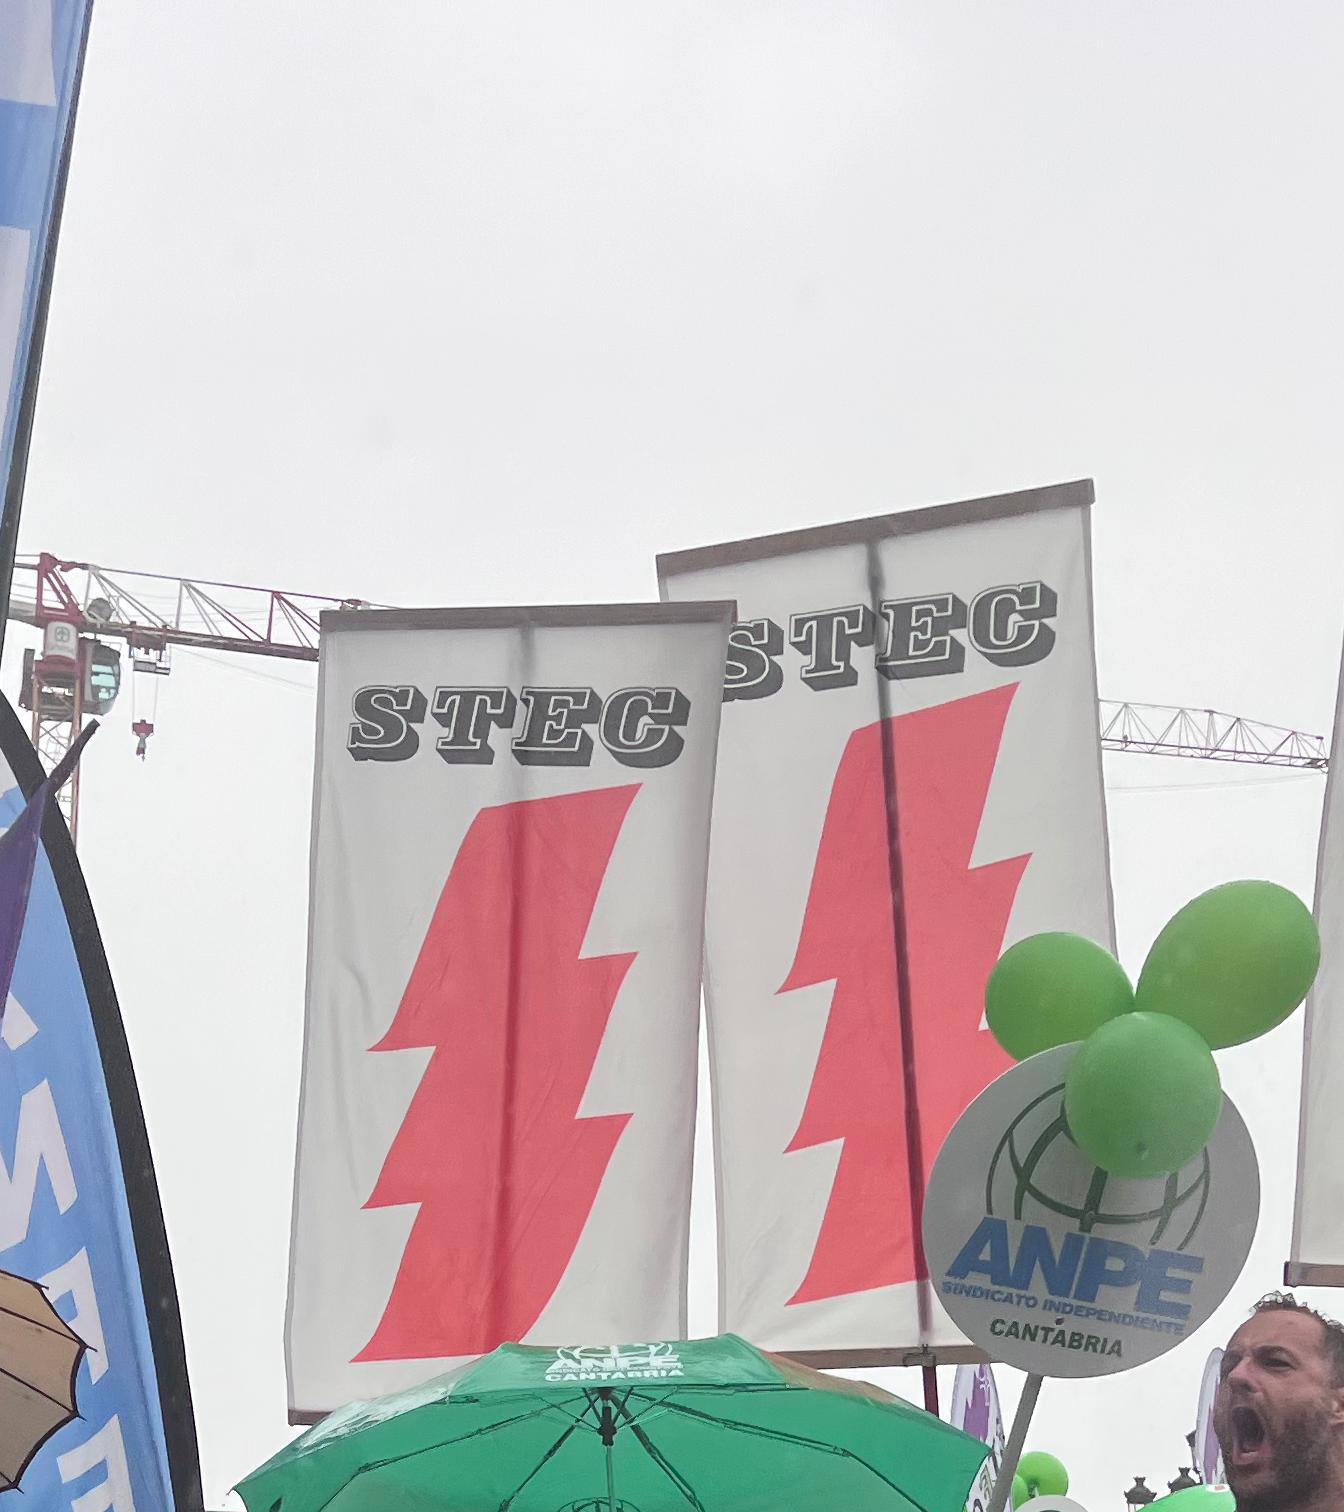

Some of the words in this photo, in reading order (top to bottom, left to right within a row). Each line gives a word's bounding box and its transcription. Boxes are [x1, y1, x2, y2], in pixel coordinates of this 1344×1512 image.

[722, 580, 1058, 703] STEC
[347, 685, 691, 768] STEC
[945, 1216, 1204, 1320] ANPE
[942, 1281, 1037, 1309] SINDICATO
[1042, 1298, 1185, 1336] INDEPENDIENTE
[545, 1355, 679, 1374] ANPE
[990, 1318, 1123, 1358] CANTABRIA
[545, 1369, 685, 1382] CANTABRIA
